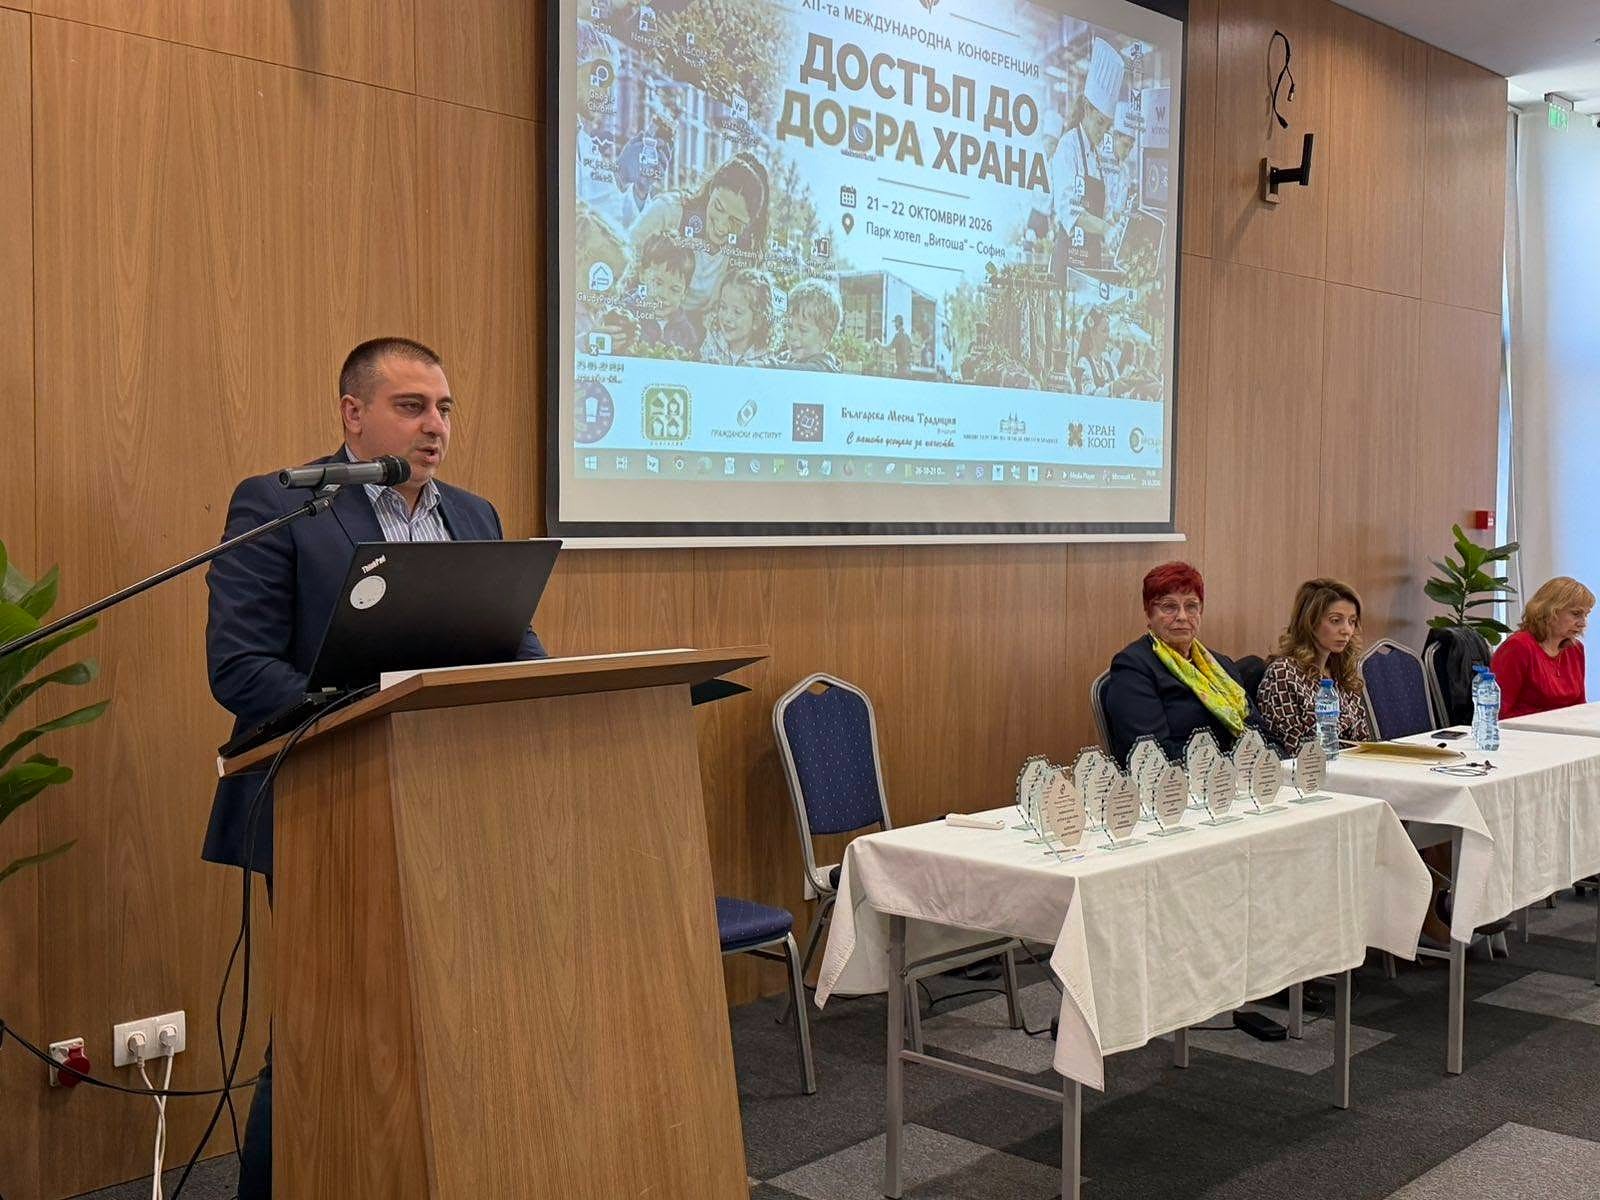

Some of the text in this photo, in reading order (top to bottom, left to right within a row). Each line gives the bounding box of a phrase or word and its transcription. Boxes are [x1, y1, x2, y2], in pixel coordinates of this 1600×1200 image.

[844, 7, 952, 51] МЕЖДУНАРОДНА
[957, 41, 1039, 79] КОНФЕРЕНЦИЯ
[800, 32, 1038, 138] ДОСТЪП ДО
[776, 89, 1051, 194] ДОБРА ХРАНА
[866, 196, 879, 212] 21
[891, 201, 905, 217] 22
[908, 204, 966, 227] ОКТОМВРИ
[968, 216, 993, 233] 2026
[866, 221, 891, 240] Парк
[893, 229, 921, 244] хотел
[976, 241, 1006, 258] София
[841, 407, 957, 427] Българска Месна Традиция
[1087, 424, 1116, 436] ХРАН
[1087, 437, 1116, 449] КООП
